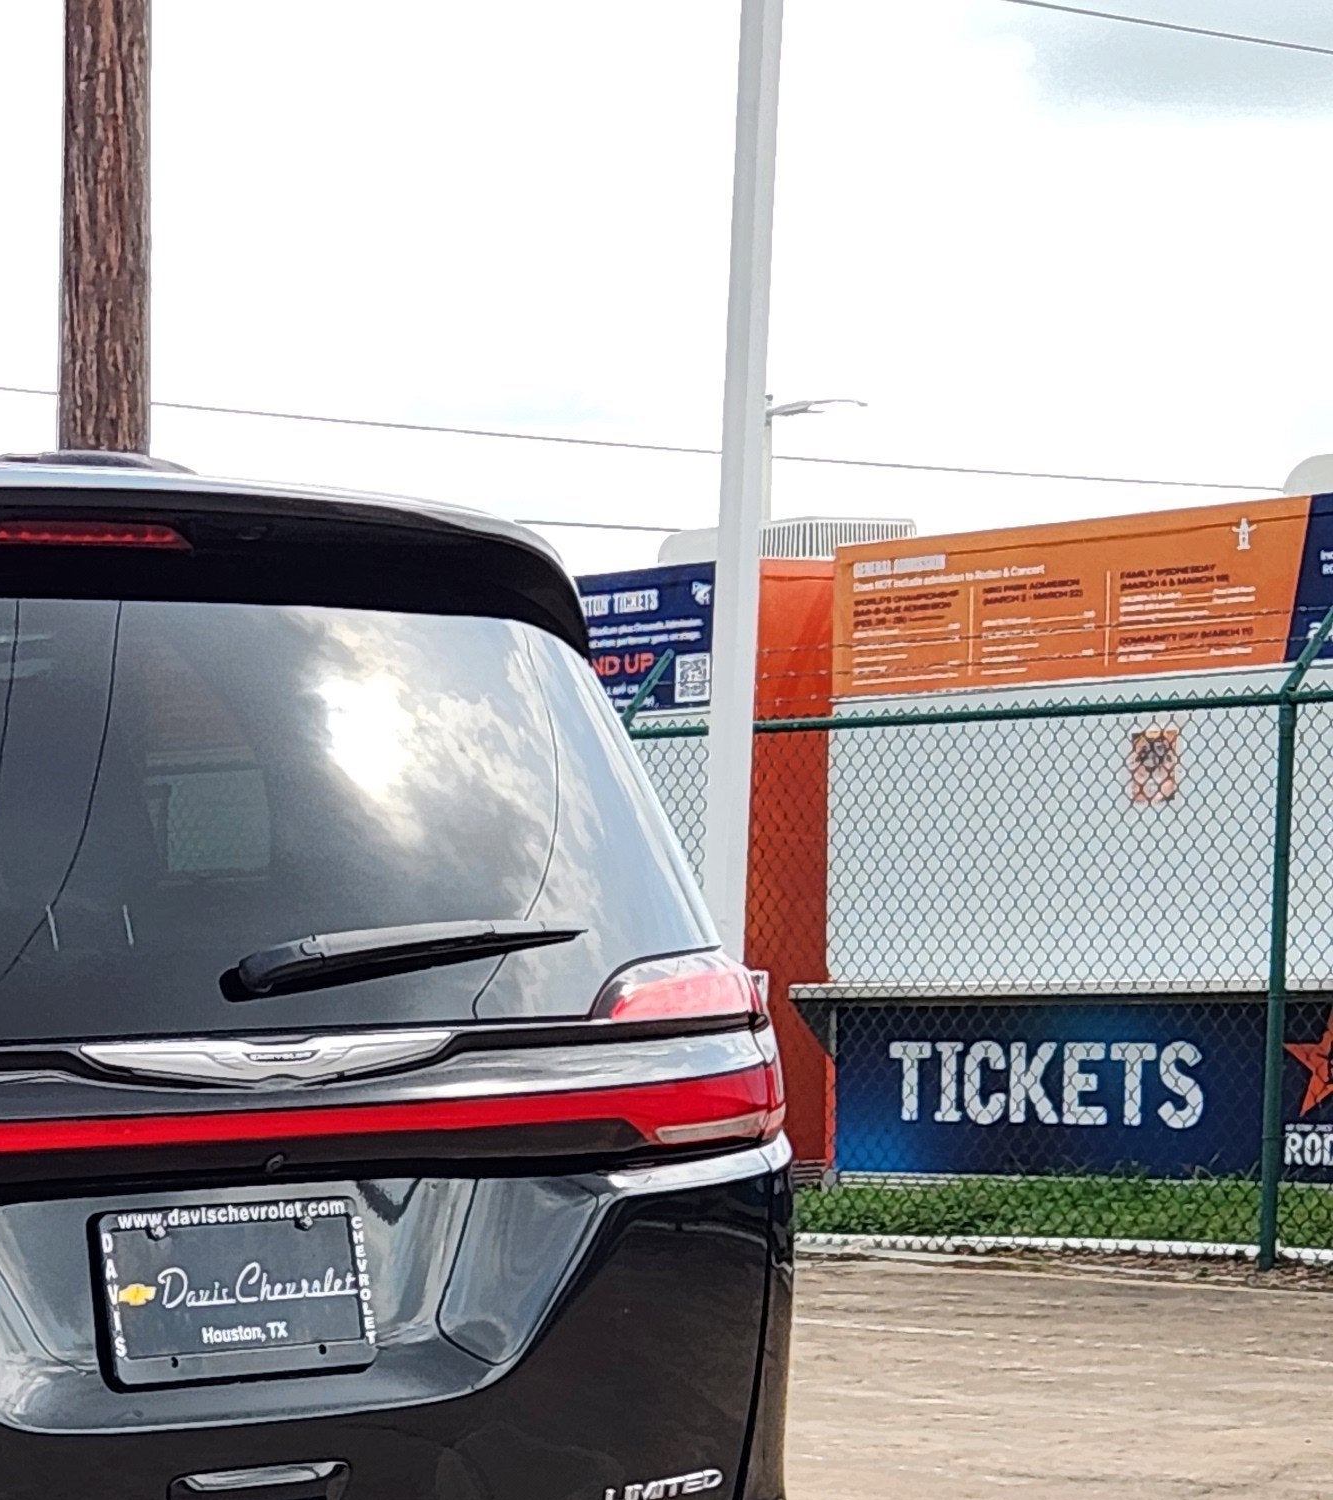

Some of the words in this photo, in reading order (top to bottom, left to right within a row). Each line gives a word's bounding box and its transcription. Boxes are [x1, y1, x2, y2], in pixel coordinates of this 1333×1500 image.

[613, 588, 659, 614] TICKETS
[624, 652, 654, 674] UP
[889, 1040, 1203, 1129] TICKETS
[117, 1200, 346, 1230] www.davischevrolet.com
[157, 1267, 236, 1309] Davis
[235, 1261, 359, 1304] Chevrolet
[350, 1215, 377, 1345] CHEVROLET
[201, 1325, 266, 1345] Houston,
[267, 1321, 288, 1338] TX
